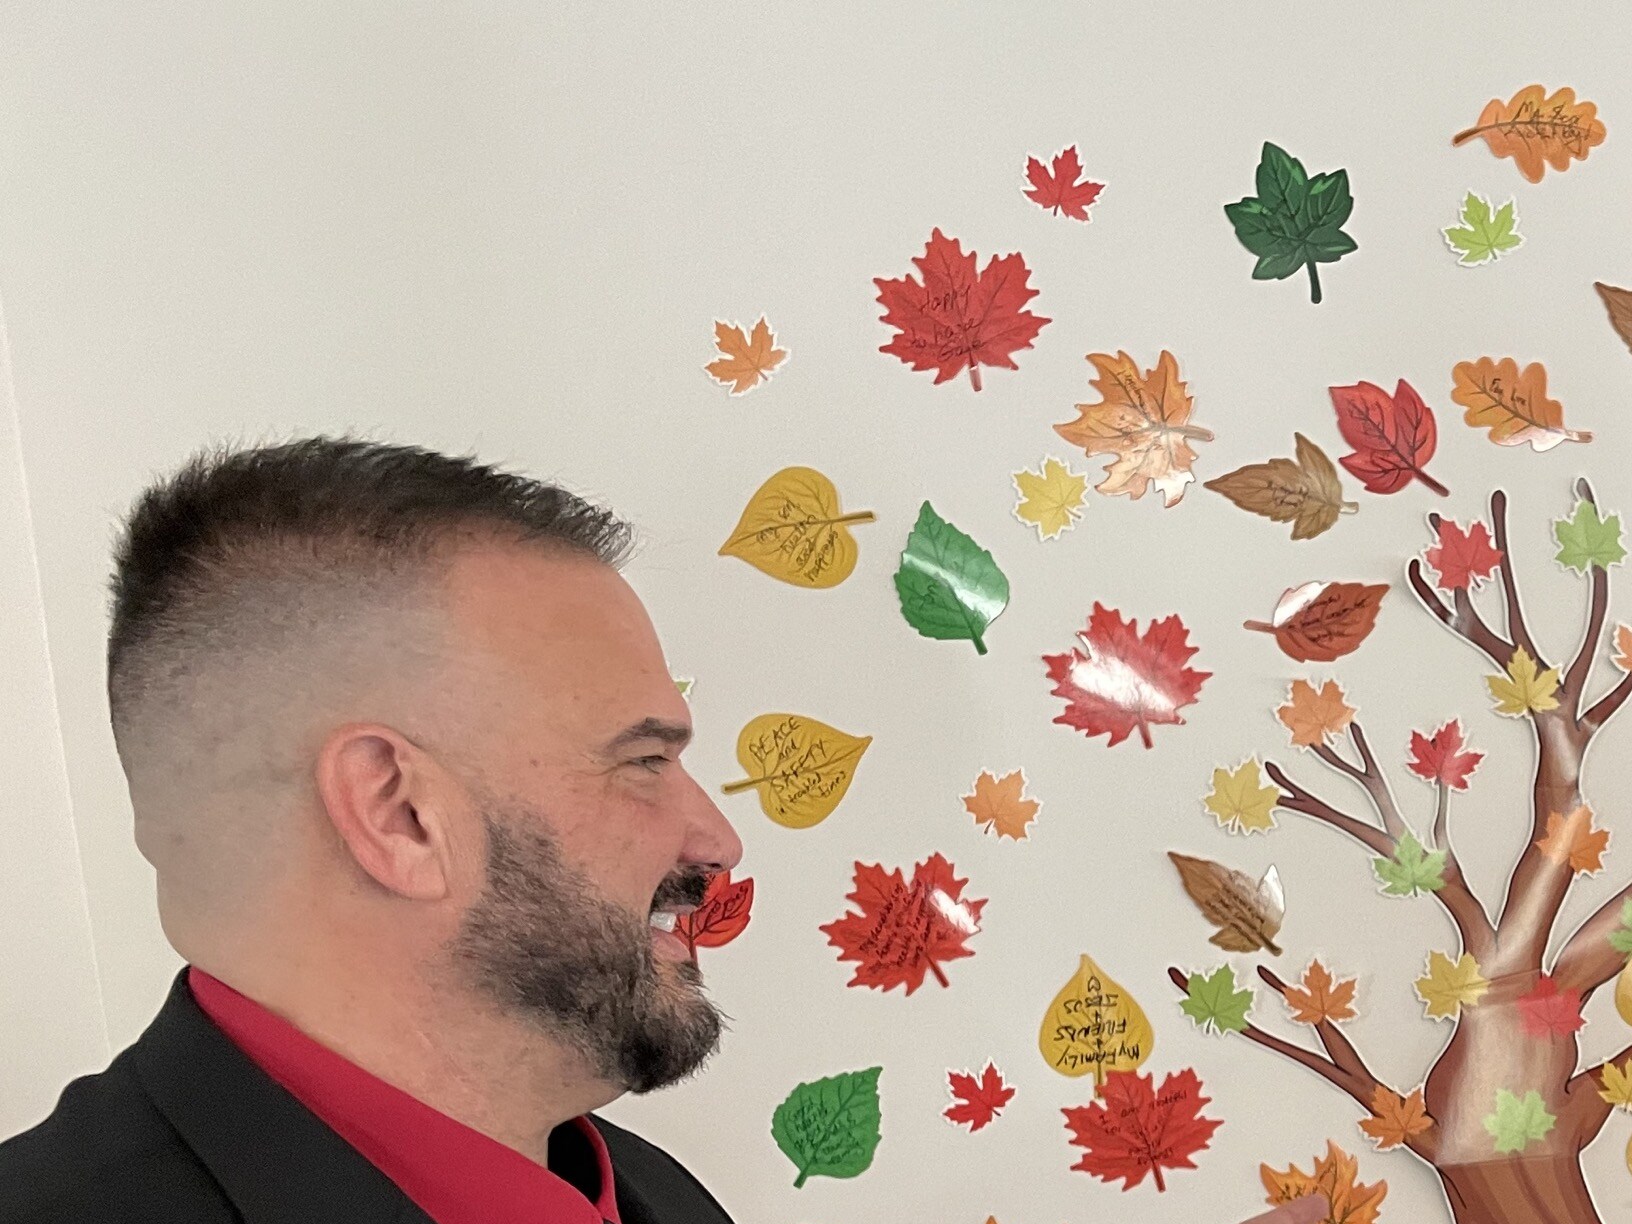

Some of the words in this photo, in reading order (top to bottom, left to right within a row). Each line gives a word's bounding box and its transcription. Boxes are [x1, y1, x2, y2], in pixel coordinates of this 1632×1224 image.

[748, 716, 801, 761] PEACE
[779, 738, 801, 761] and
[770, 738, 828, 795] SAFETY
[1063, 993, 1119, 1015] JESUS
[1053, 1018, 1127, 1043] FRIENDS
[1056, 1044, 1117, 1070] FAMILY
[1118, 1041, 1140, 1061] My
